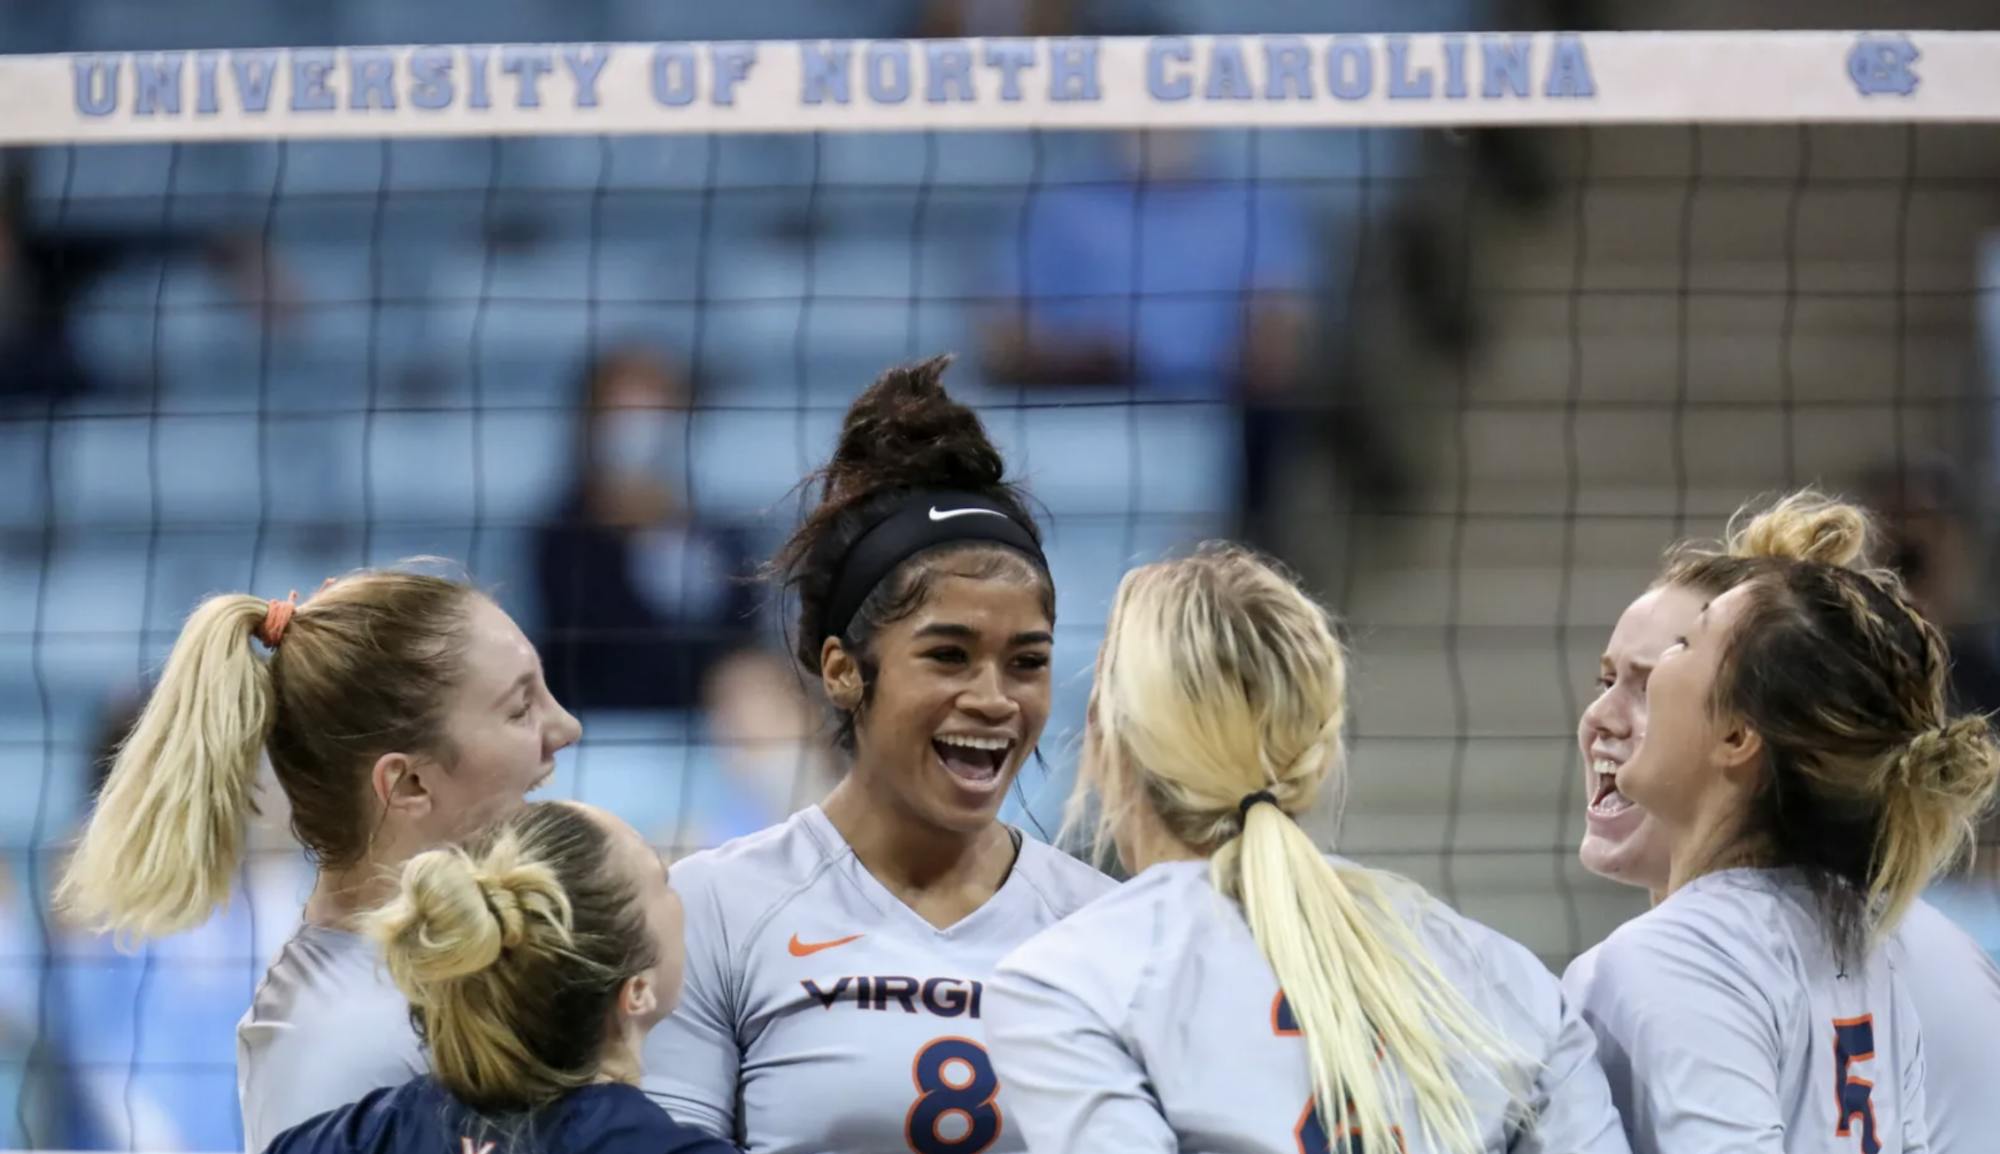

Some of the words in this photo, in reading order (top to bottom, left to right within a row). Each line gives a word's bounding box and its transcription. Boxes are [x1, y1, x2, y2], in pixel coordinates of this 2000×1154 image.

[73, 48, 607, 117] UNIVERSITY
[649, 43, 759, 108] OF
[800, 40, 1101, 103] NORTH
[1146, 34, 1597, 100] CAROLINA
[800, 975, 984, 1019] VIRGI
[905, 1035, 1003, 1154] 8
[1832, 1013, 1882, 1154] 5
